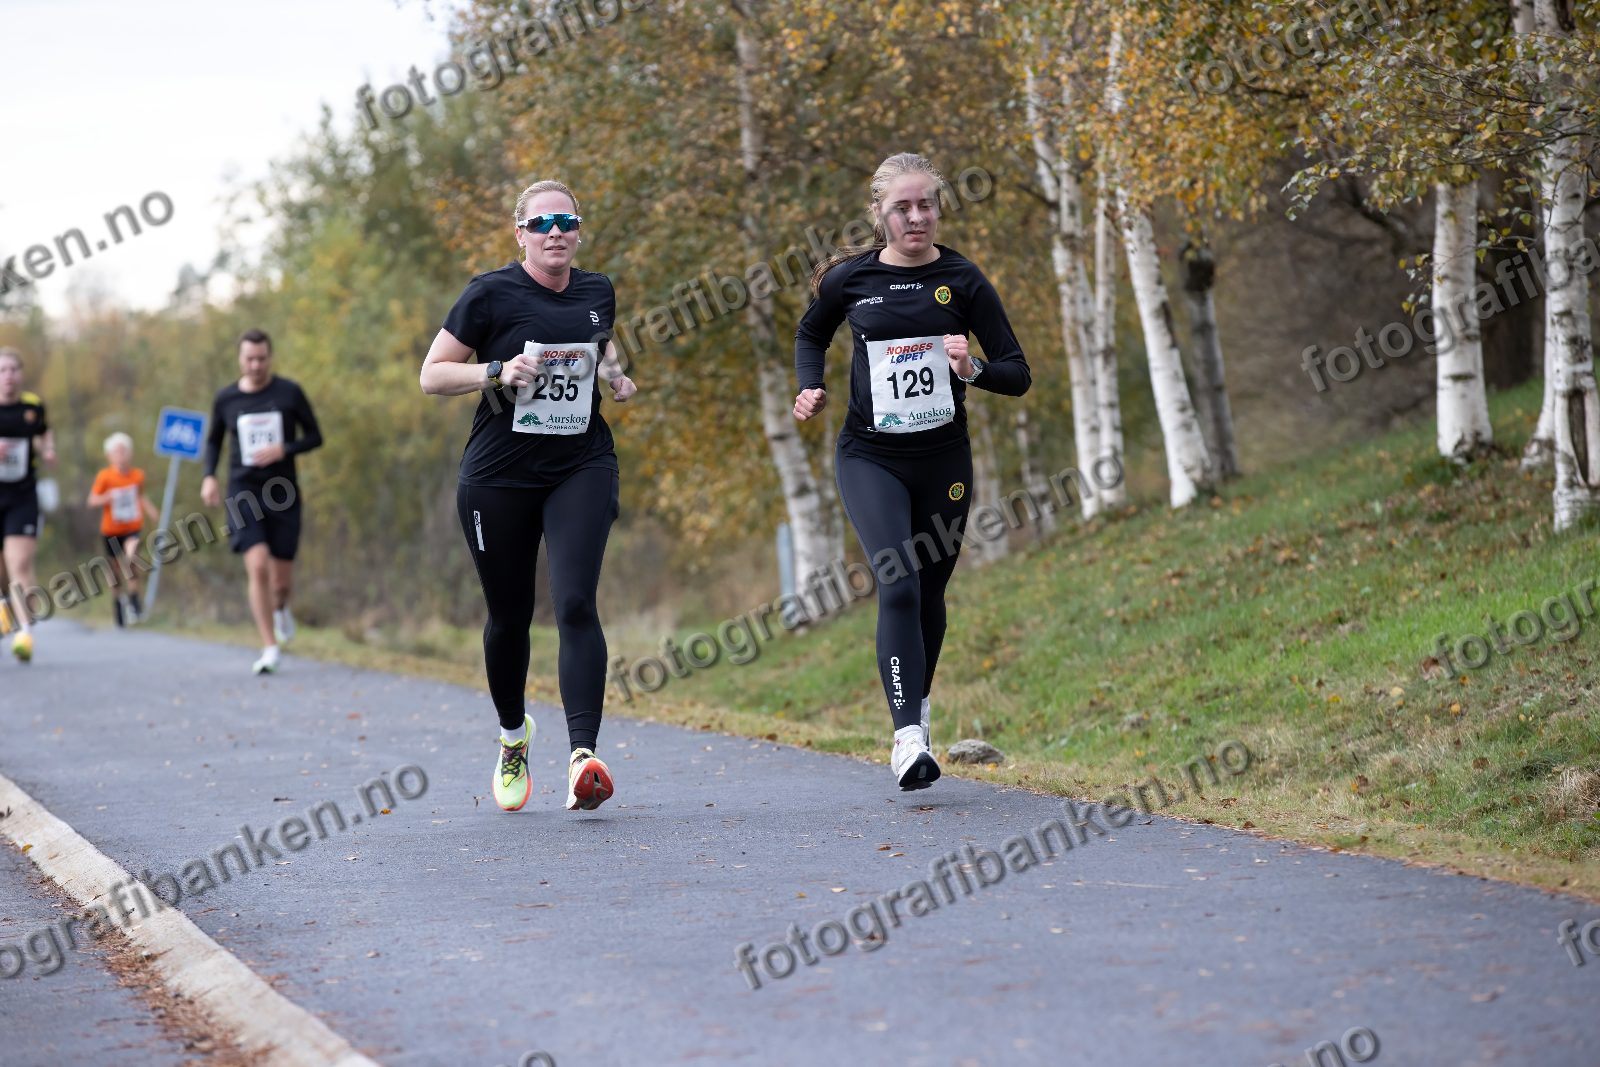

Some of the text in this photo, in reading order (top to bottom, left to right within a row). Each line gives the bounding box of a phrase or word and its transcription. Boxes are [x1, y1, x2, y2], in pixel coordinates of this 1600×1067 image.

[543, 350, 586, 359] NORGES
[886, 343, 934, 355] NORGES
[890, 351, 926, 364] LØPET
[532, 373, 580, 402] 255
[887, 366, 934, 399] 129
[546, 413, 587, 425] Aurskog
[908, 407, 952, 421] Aurskog
[890, 656, 903, 698] CRAFT
